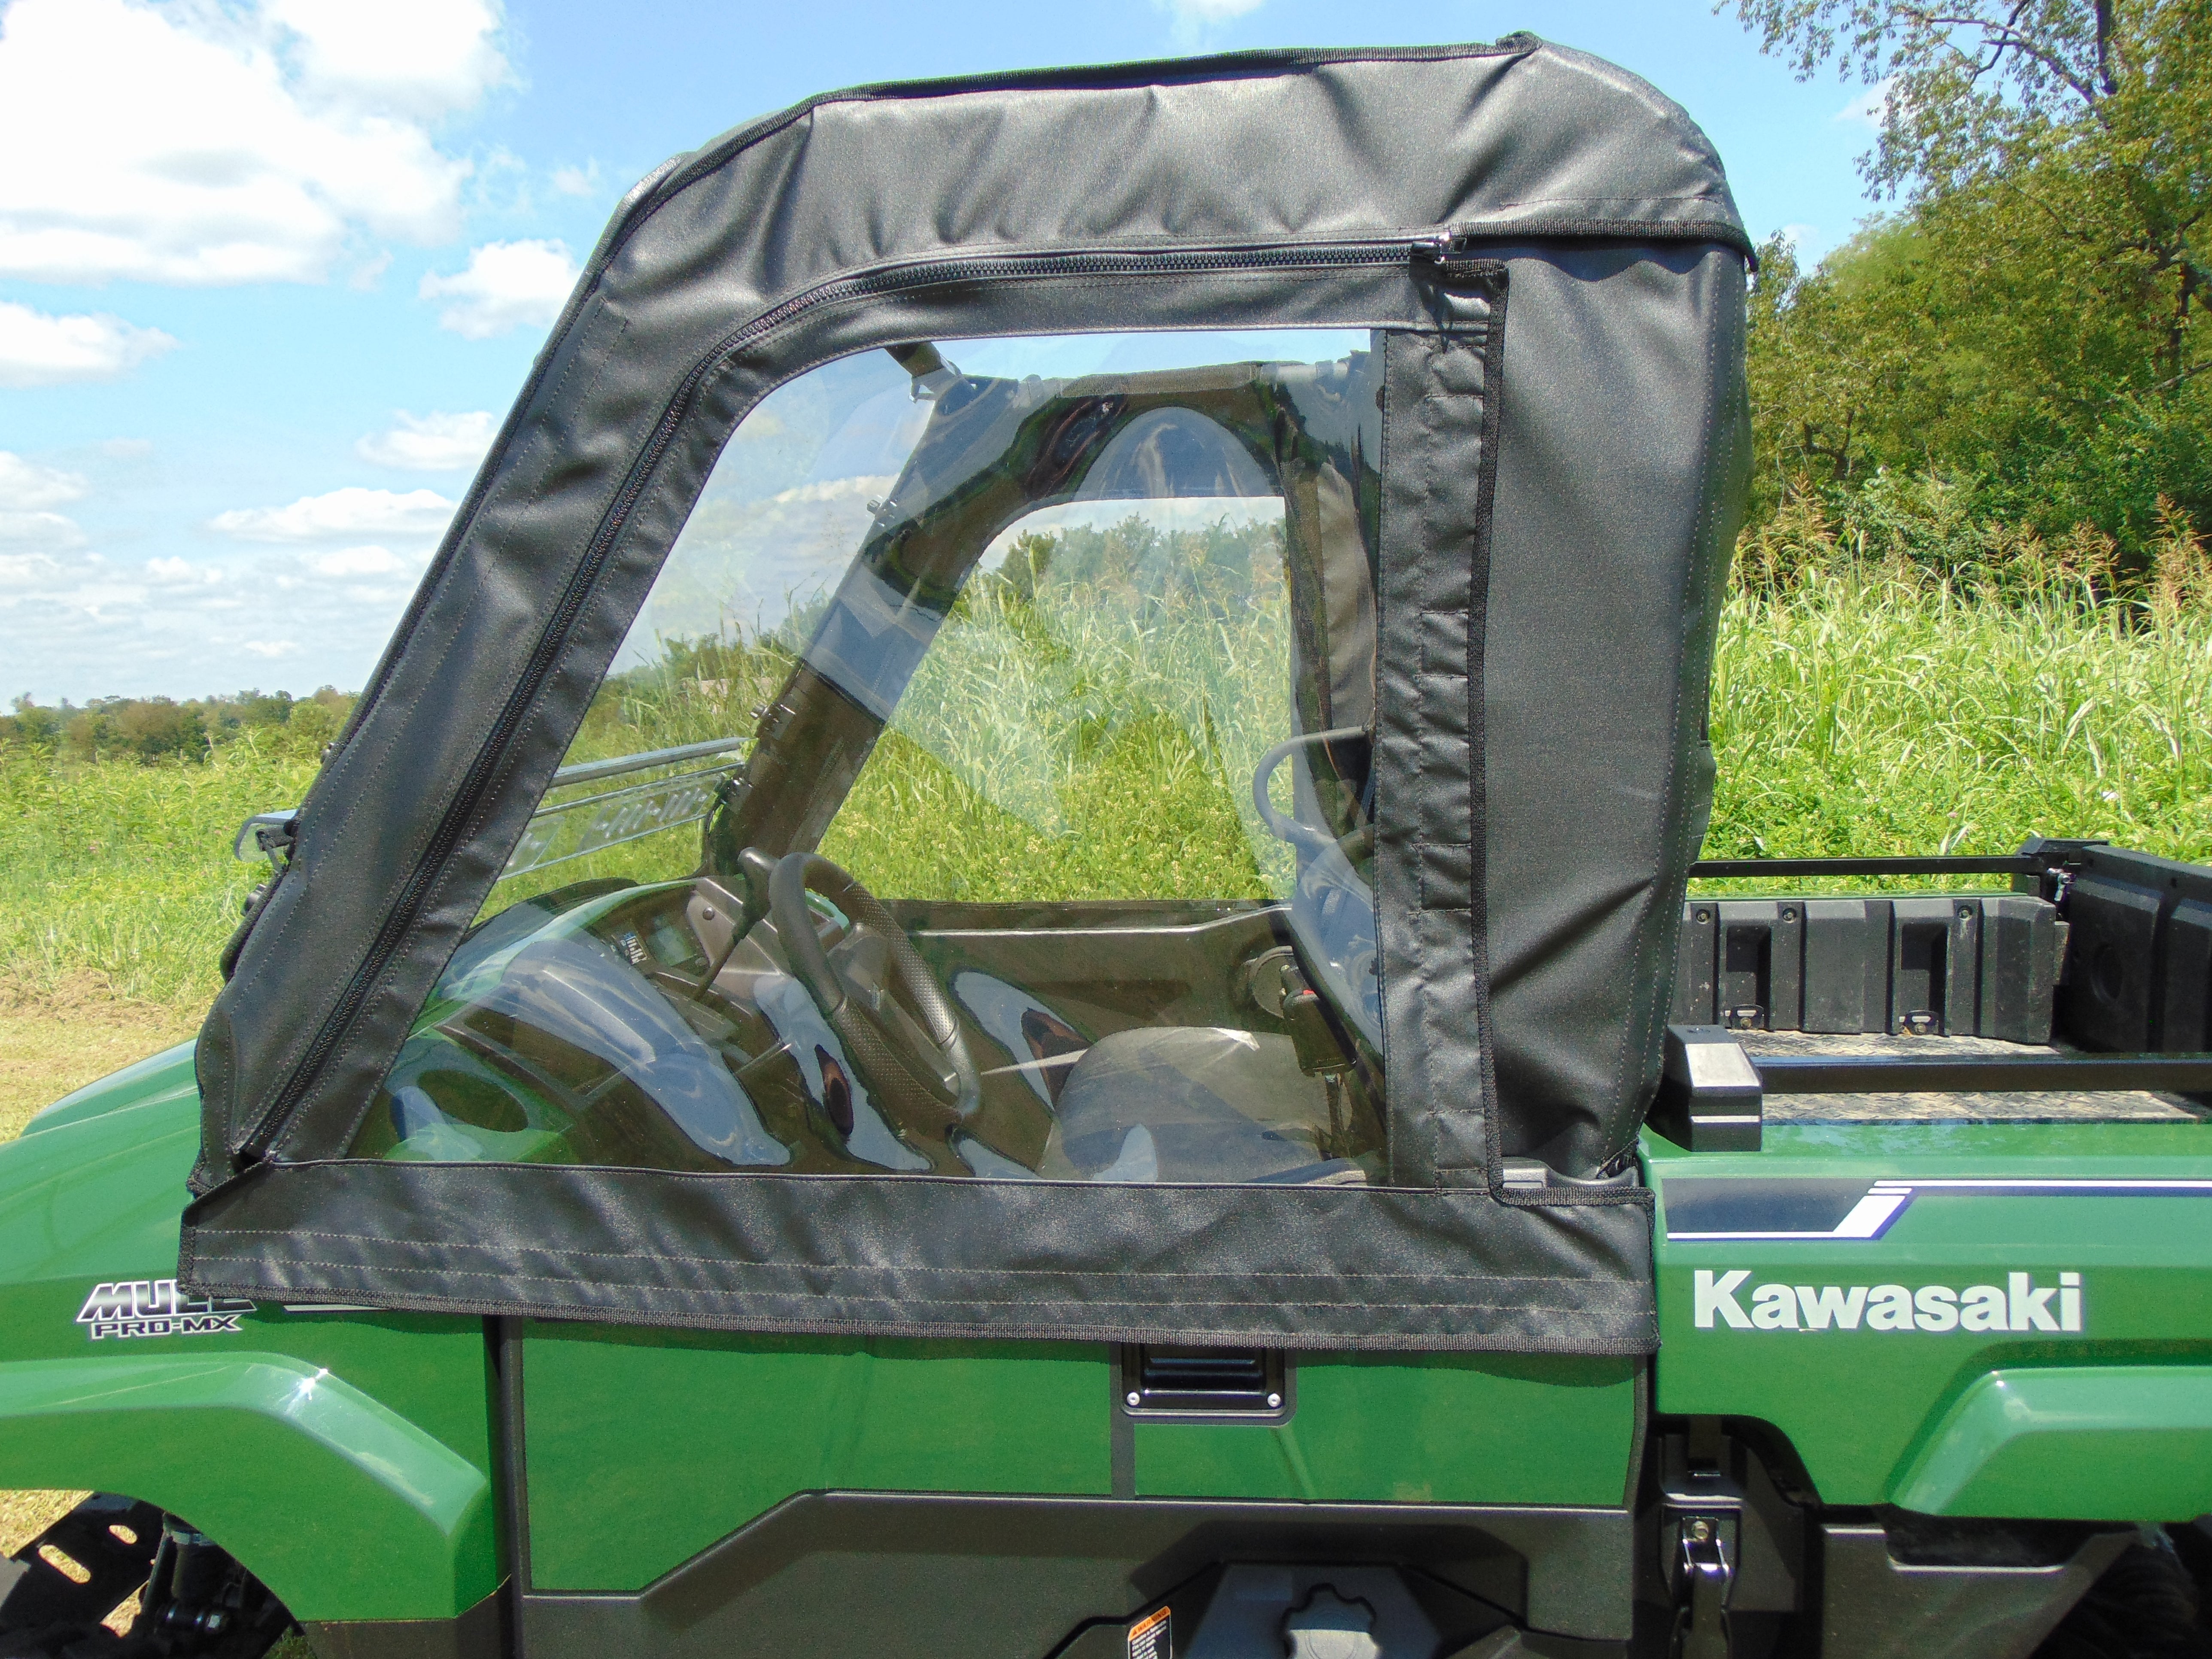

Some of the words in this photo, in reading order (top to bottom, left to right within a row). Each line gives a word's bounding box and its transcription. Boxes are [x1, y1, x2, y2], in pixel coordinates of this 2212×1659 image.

[1694, 1270, 2080, 1331] Kawasaki
[91, 1313, 243, 1340] PRO-MX
[1137, 1608, 1167, 1633] WARNING
